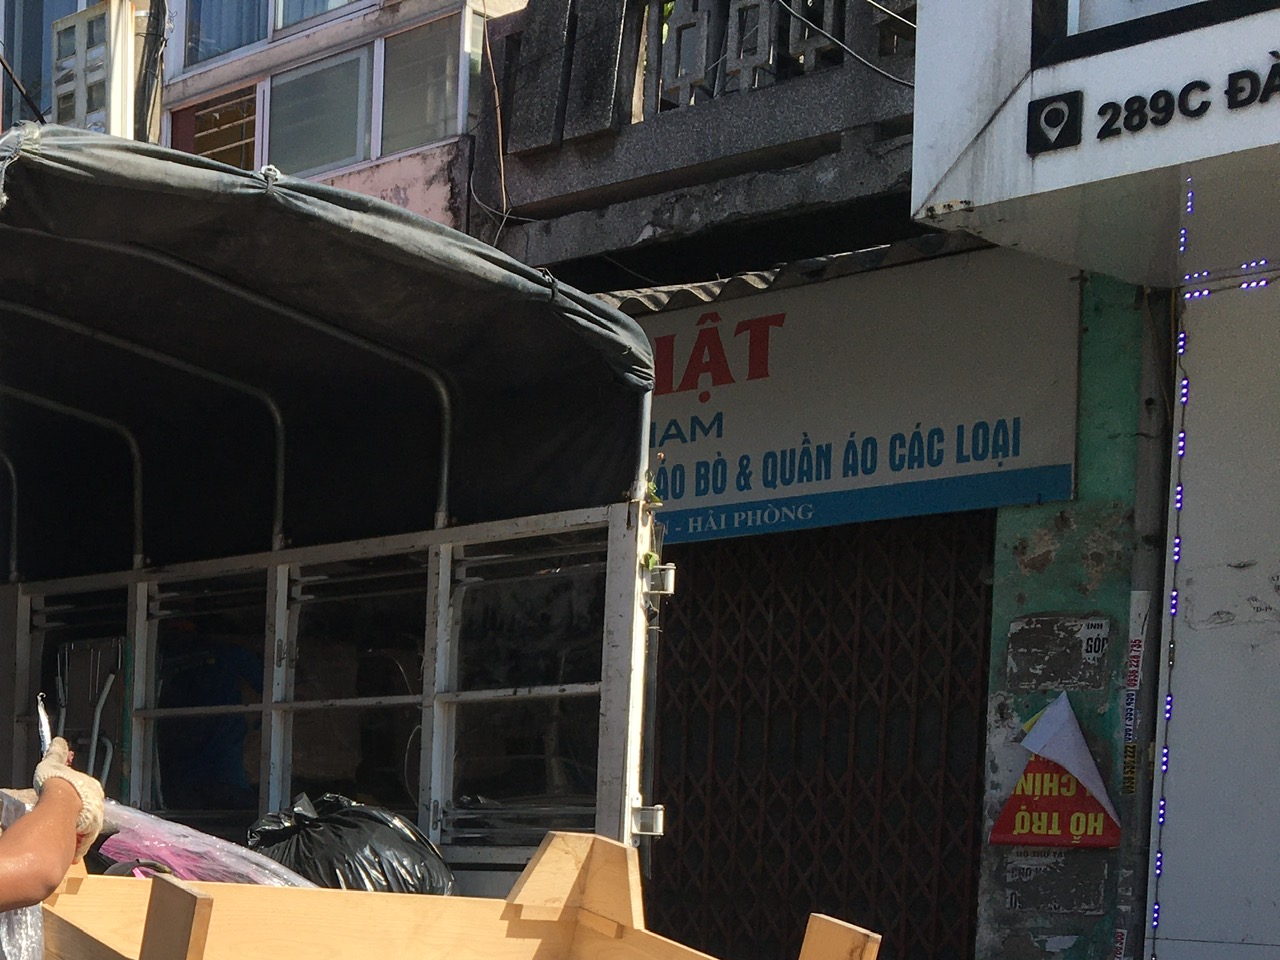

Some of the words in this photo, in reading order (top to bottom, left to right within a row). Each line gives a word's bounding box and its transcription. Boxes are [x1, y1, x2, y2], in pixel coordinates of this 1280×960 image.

[1097, 80, 1212, 141] 289C
[695, 452, 727, 497] BÒ
[736, 454, 752, 491] &
[762, 431, 832, 489] QUẦN
[842, 431, 878, 478] ÁO
[889, 422, 945, 472] CÁC
[956, 416, 1021, 467] LOẠI
[687, 510, 726, 534] HẢI
[733, 503, 814, 531] PHÒNG
[1011, 773, 1077, 801] CHÍN
[1012, 805, 1062, 836] TRỢ
[1070, 811, 1104, 844] HỖ
